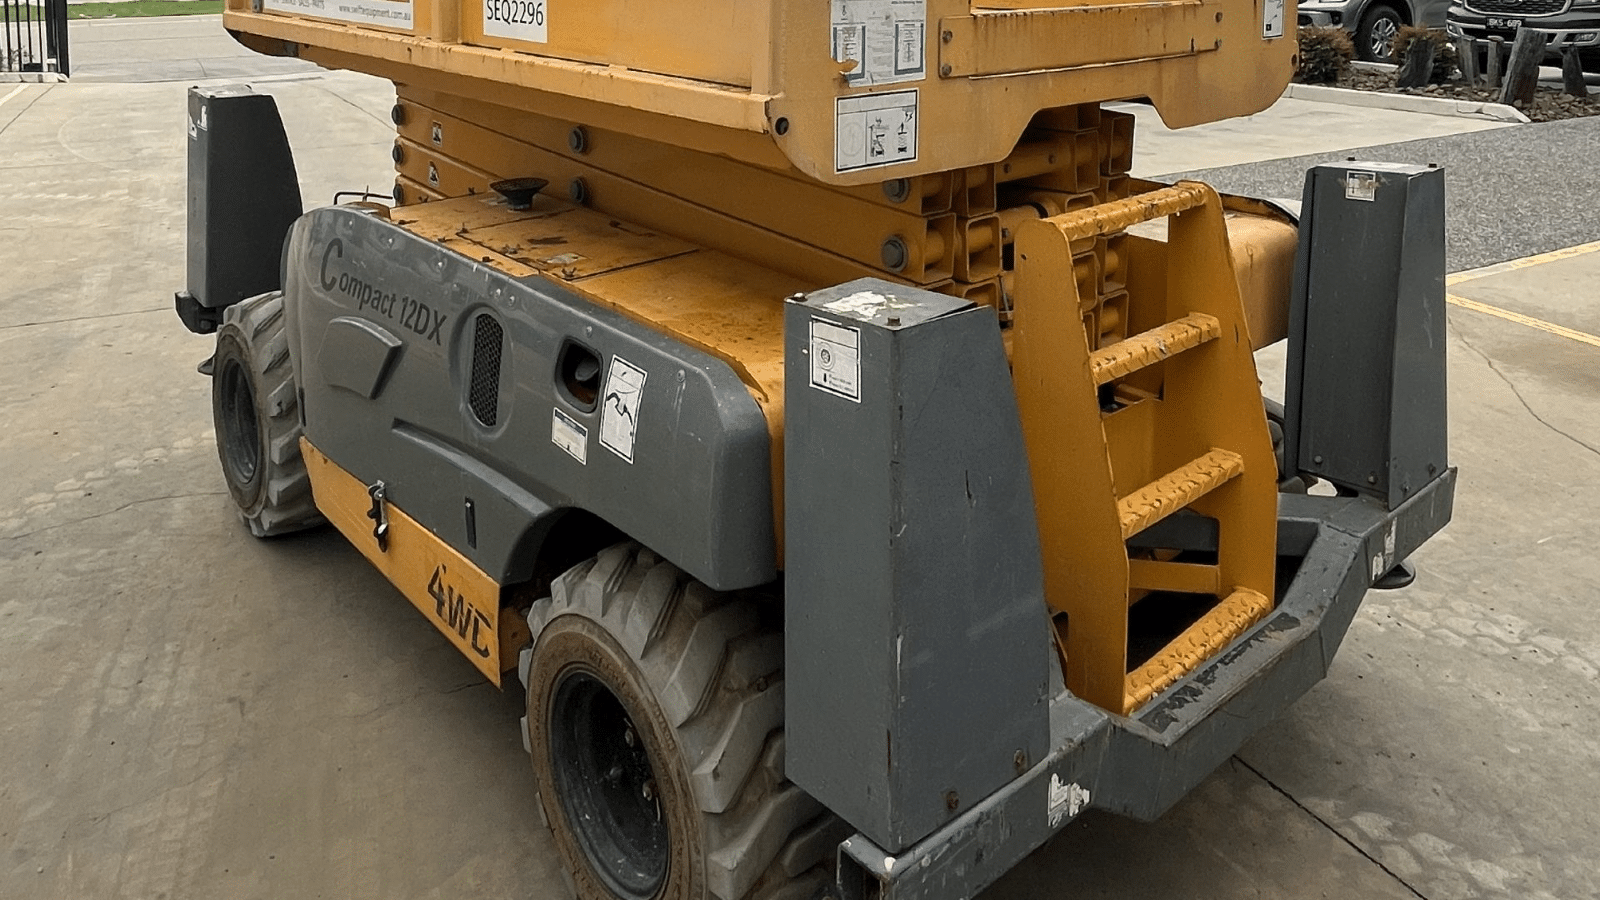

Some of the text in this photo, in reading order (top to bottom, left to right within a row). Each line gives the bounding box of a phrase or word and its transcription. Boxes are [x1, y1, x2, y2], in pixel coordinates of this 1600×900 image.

[487, 0, 544, 26] SEQ2296
[320, 237, 447, 346] Compact 12DX
